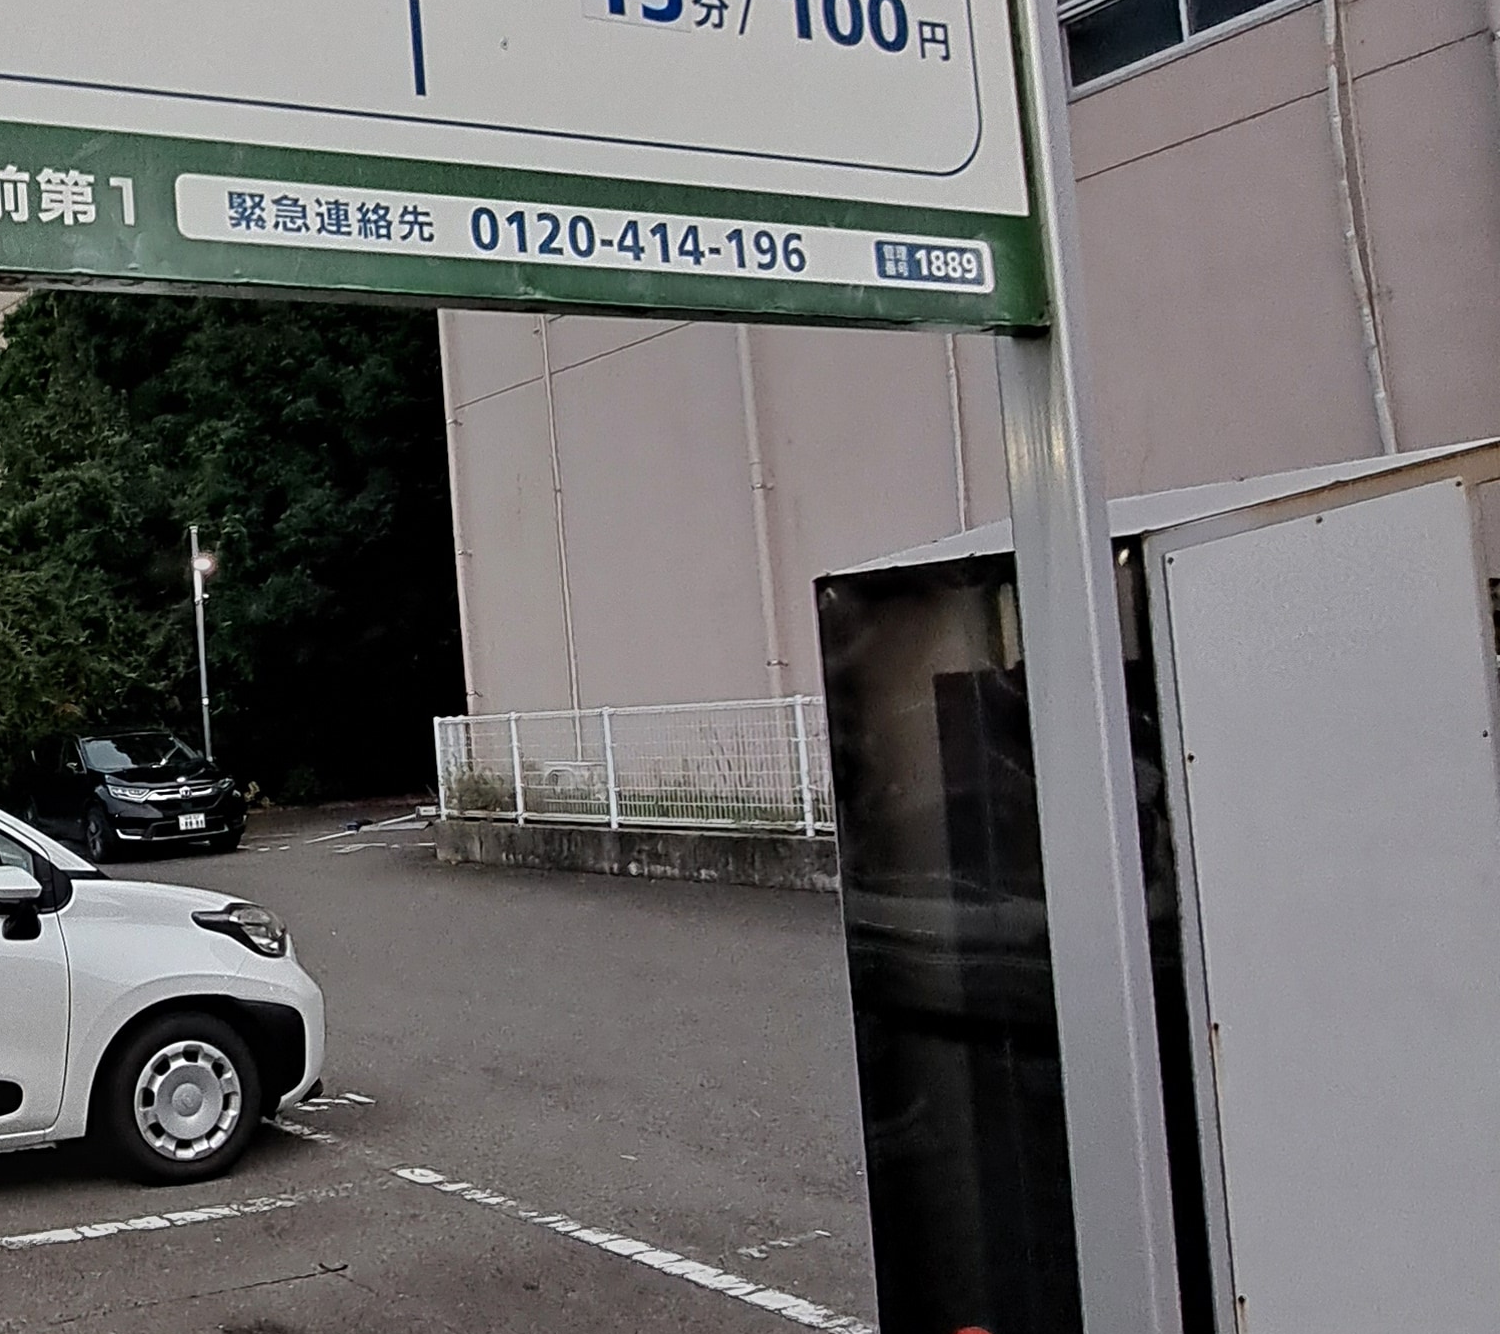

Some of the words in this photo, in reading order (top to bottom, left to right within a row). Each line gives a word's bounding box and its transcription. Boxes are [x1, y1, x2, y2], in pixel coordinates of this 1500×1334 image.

[226, 190, 435, 243] 緊急連絡先
[470, 207, 808, 274] 0120-414-196
[914, 249, 978, 279] 1889
